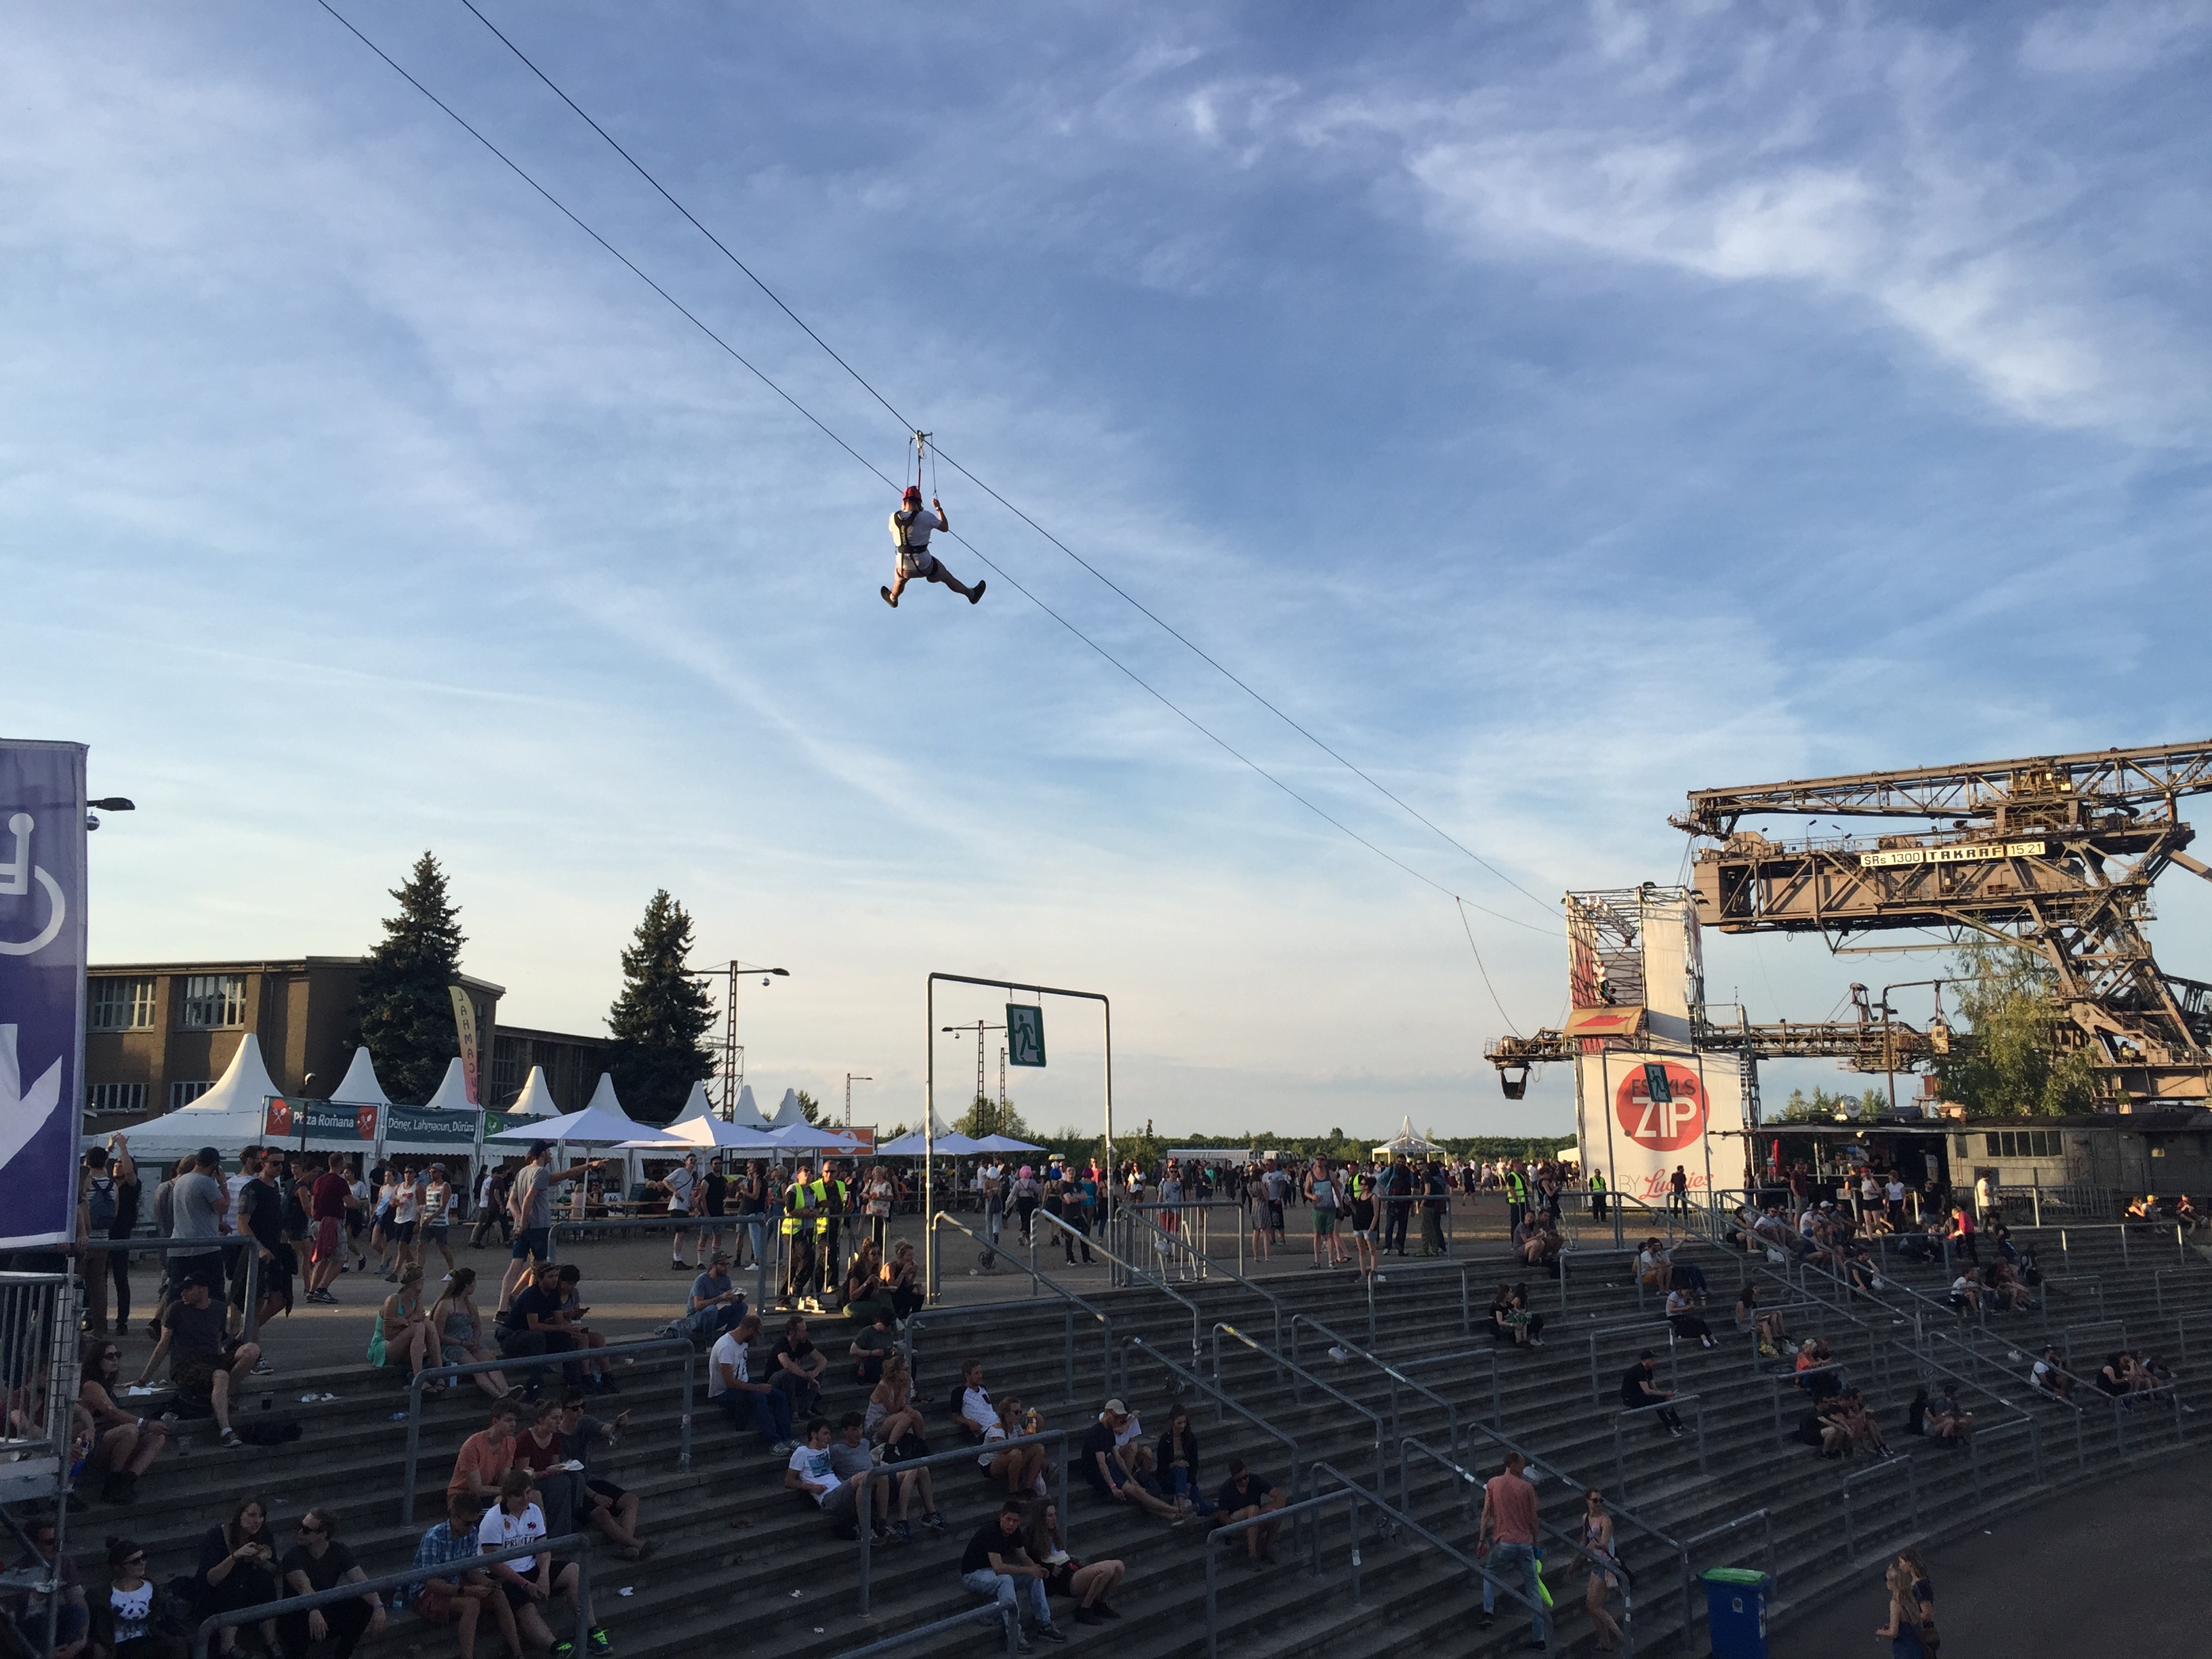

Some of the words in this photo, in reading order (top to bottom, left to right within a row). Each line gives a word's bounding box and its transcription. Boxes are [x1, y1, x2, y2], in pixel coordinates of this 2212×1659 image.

[1864, 855, 1886, 865] SRs
[1891, 853, 1920, 863] 1300
[1928, 847, 2002, 860] TAKRAF
[1632, 1079, 1696, 1097] FSLS
[318, 1113, 354, 1128] Romana
[1632, 1097, 1697, 1138] ZIP
[1618, 1174, 1640, 1193] BY
[1639, 1168, 1714, 1200] Lucies
